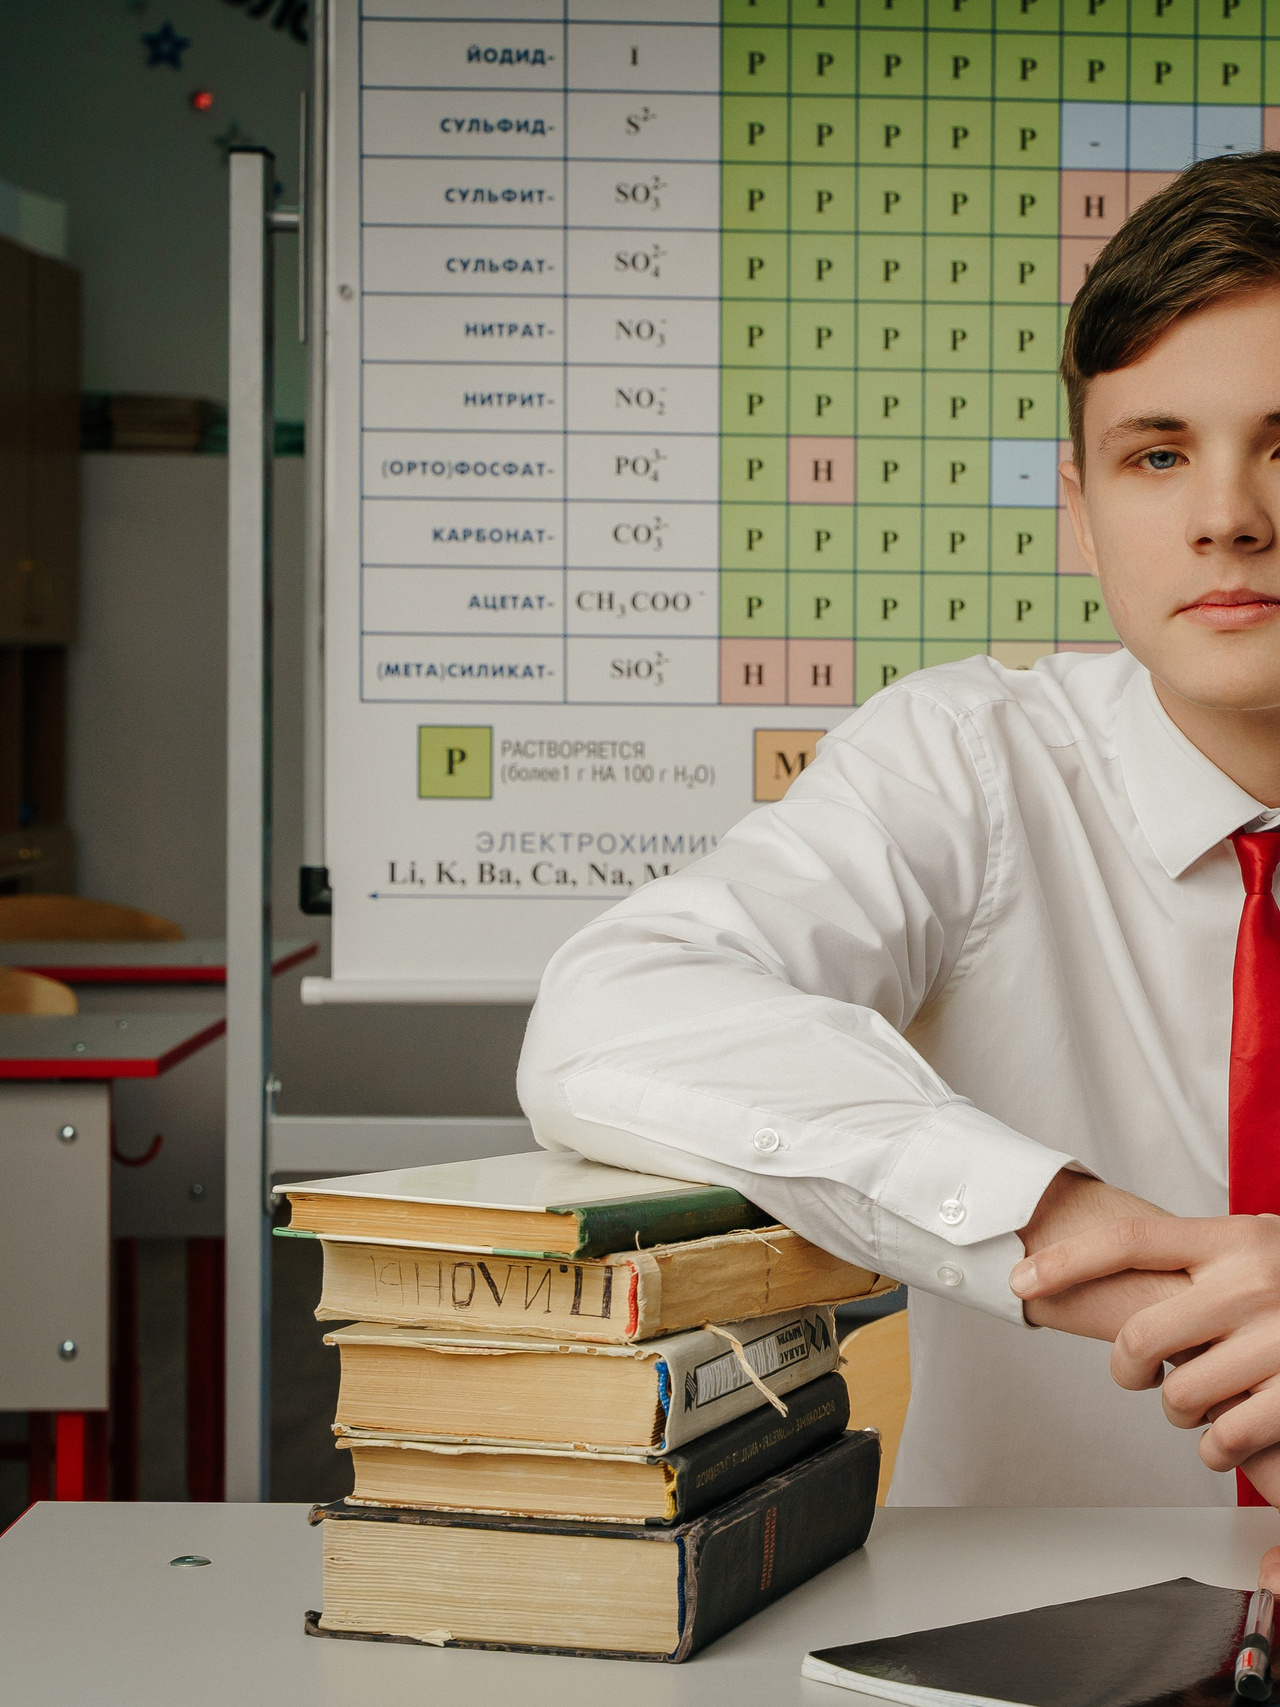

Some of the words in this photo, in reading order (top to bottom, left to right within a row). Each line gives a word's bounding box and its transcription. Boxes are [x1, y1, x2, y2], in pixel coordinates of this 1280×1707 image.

[747, 51, 766, 75] Р
[816, 52, 834, 76] Р
[884, 54, 902, 78] Р
[951, 56, 970, 79] Р
[1019, 58, 1038, 81] Р
[1087, 59, 1105, 83] Р
[1154, 61, 1172, 85] Р
[1221, 63, 1240, 86] Р
[747, 189, 765, 212] Р
[816, 190, 833, 213] Р
[883, 191, 901, 214] Р
[951, 192, 968, 215] Р
[1019, 194, 1036, 217] Р
[1085, 196, 1104, 218] Н
[747, 394, 764, 416] Р
[815, 395, 832, 417] Р
[882, 396, 899, 418] Р
[950, 397, 967, 419] Р
[1017, 398, 1034, 420] Р
[746, 596, 763, 619] Р
[814, 597, 831, 619] Р
[881, 598, 898, 620] Р
[949, 599, 965, 621] Р
[1016, 600, 1032, 622] Р
[1083, 601, 1100, 622] Р
[744, 664, 763, 686] Н
[812, 665, 831, 686] Н
[446, 748, 467, 776] Р
[501, 740, 645, 760] РАСТВОРЯЕТСЯ
[591, 765, 616, 782] НА
[624, 764, 654, 783] 100
[477, 862, 521, 887] Ba,
[531, 862, 577, 888] Ca,
[588, 862, 633, 888] Na,
